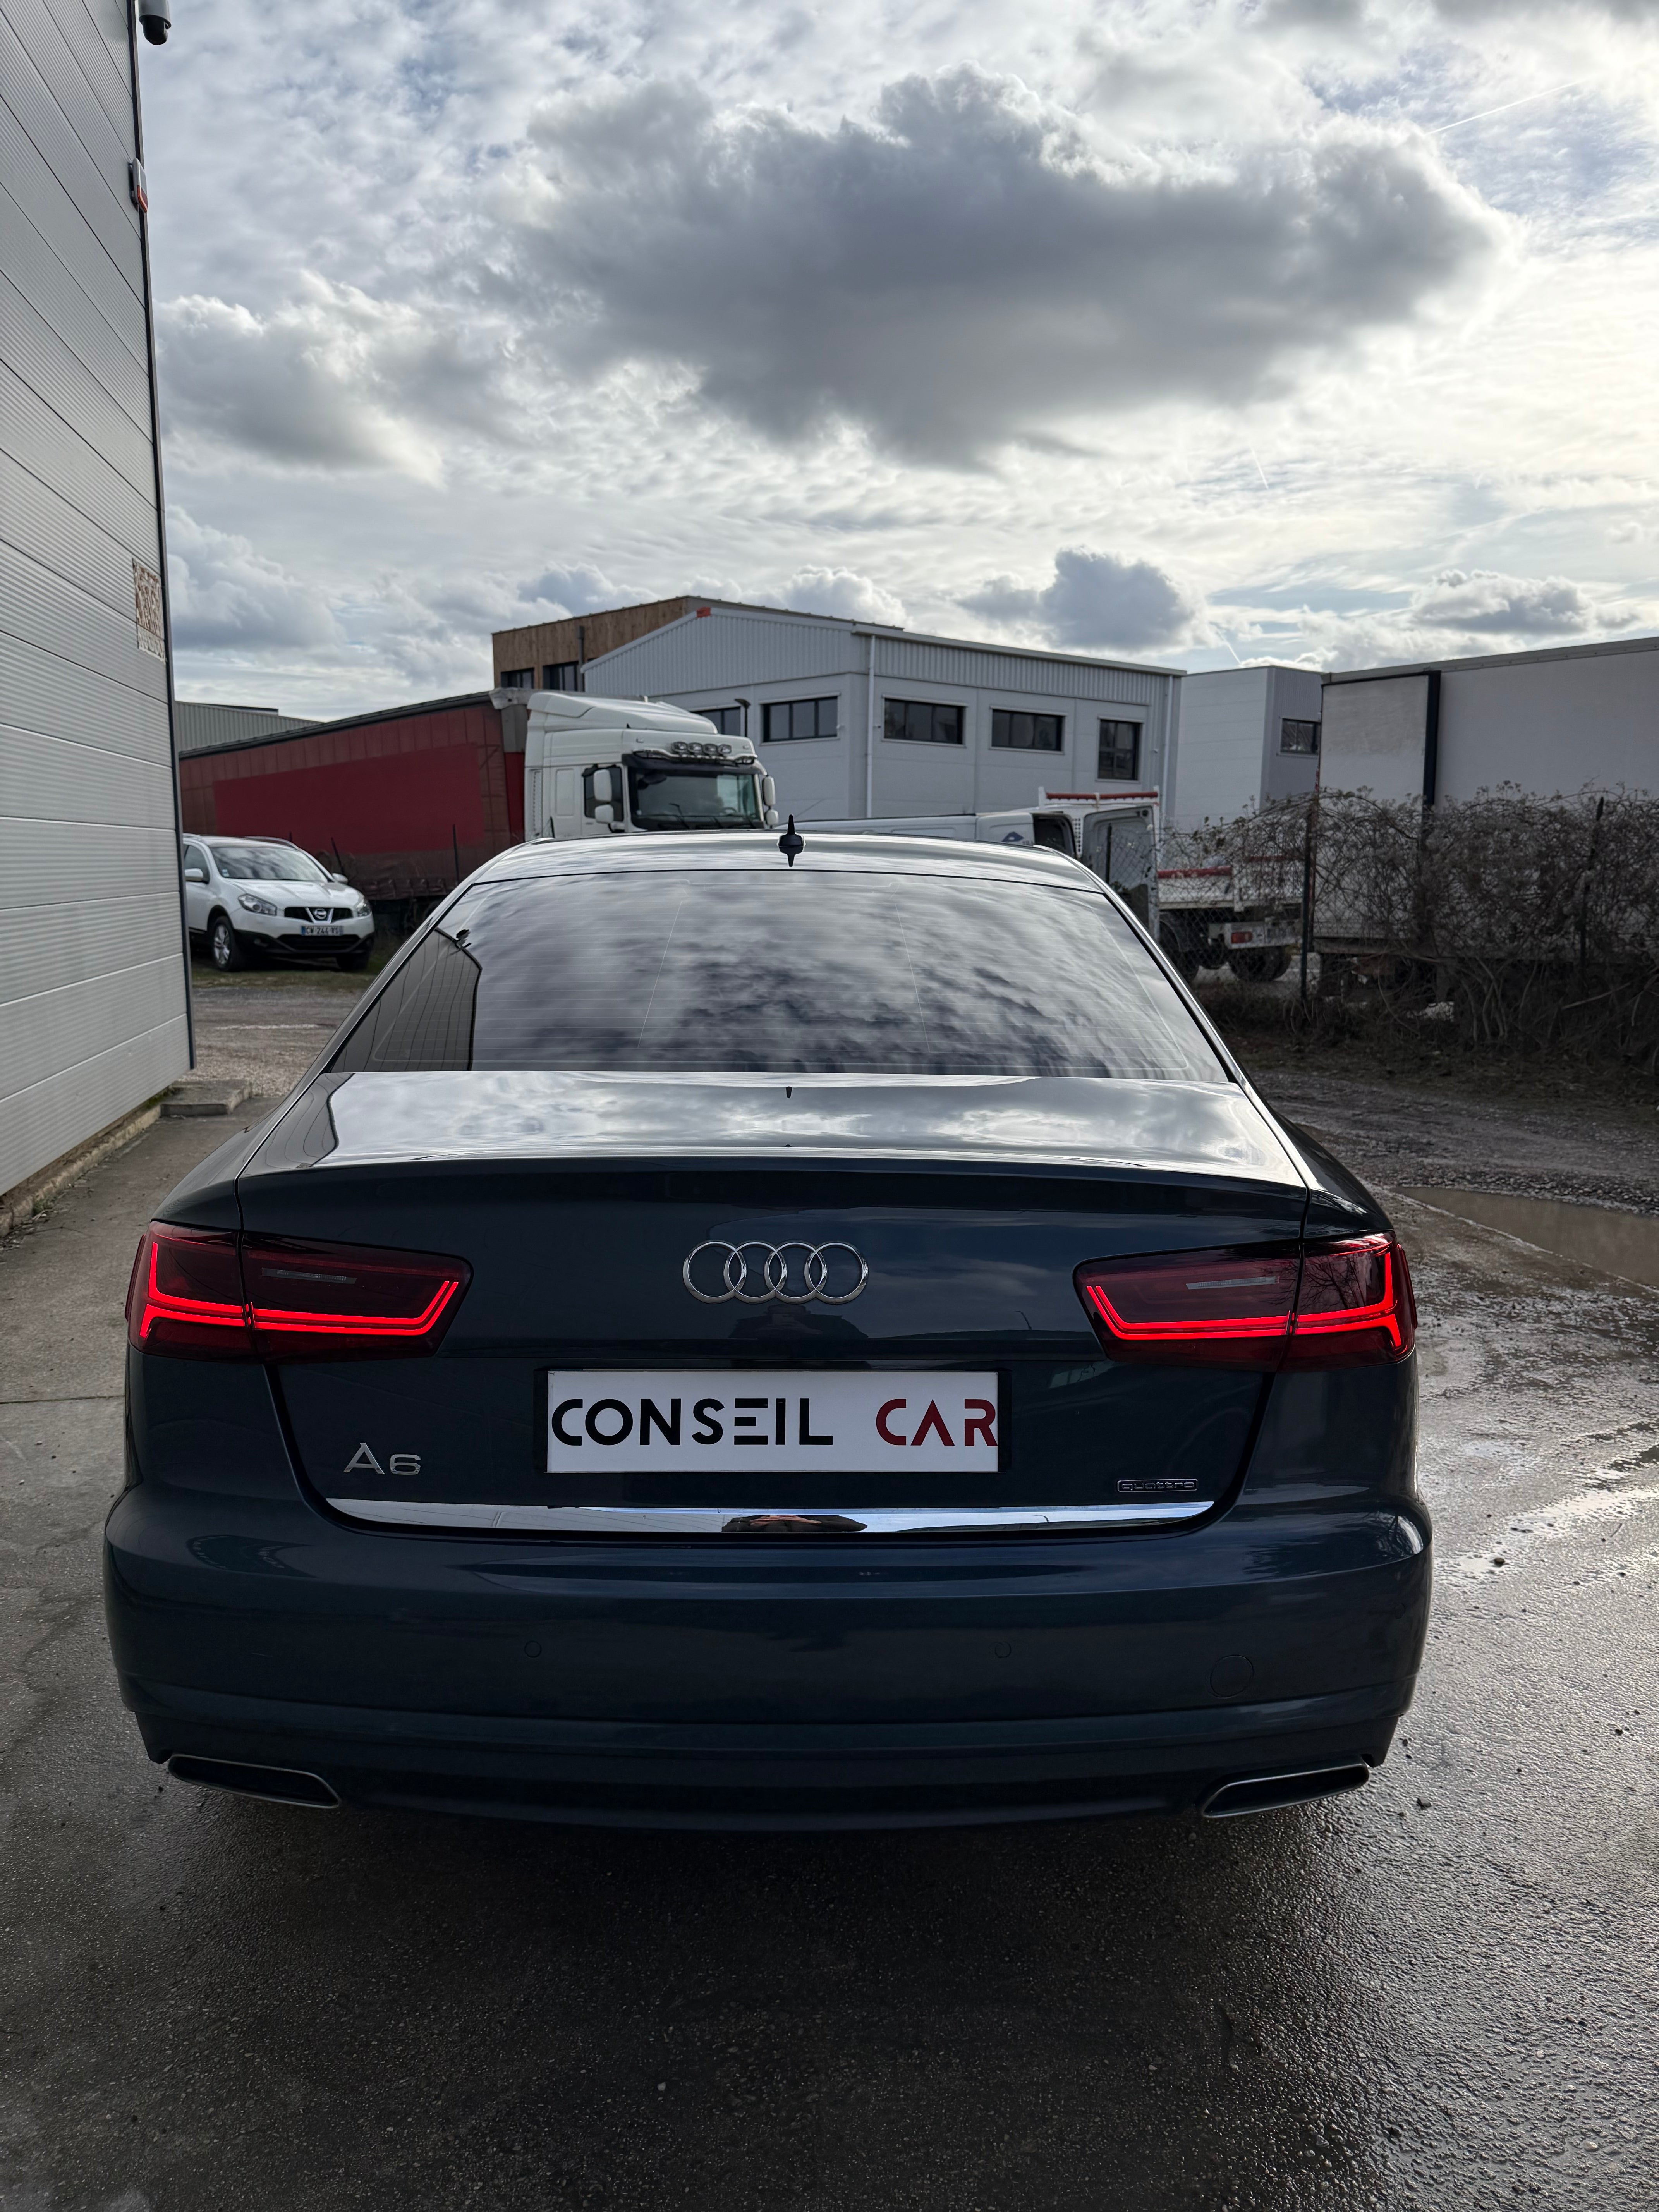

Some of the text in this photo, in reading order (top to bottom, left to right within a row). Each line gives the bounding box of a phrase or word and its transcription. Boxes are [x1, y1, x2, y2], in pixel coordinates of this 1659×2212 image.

[551, 1398, 998, 1446] CONSEIL CAR
[343, 1443, 421, 1475] A6
[1122, 1481, 1194, 1491] quattro
